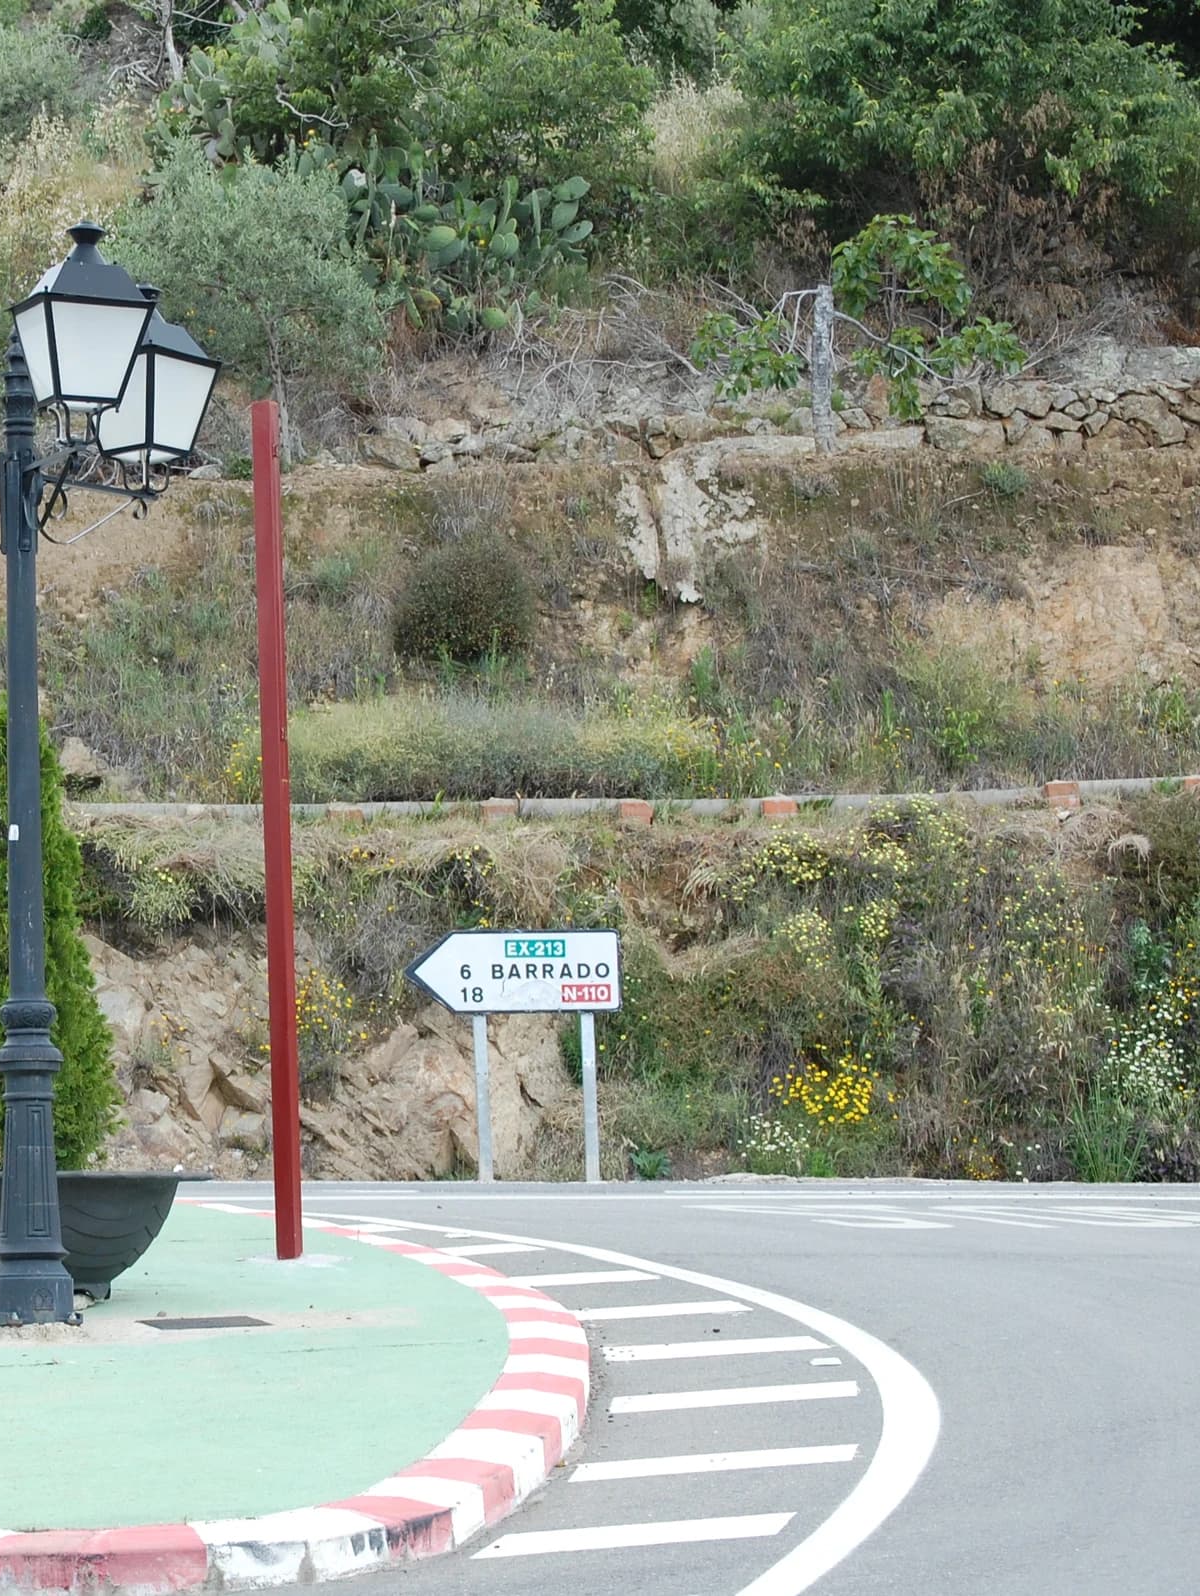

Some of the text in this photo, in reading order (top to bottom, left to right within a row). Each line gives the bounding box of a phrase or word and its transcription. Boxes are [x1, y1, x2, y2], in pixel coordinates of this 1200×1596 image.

[506, 941, 564, 956] EX-213
[460, 963, 610, 980] 6 BARRADO
[460, 985, 609, 1003] 18 N-110
